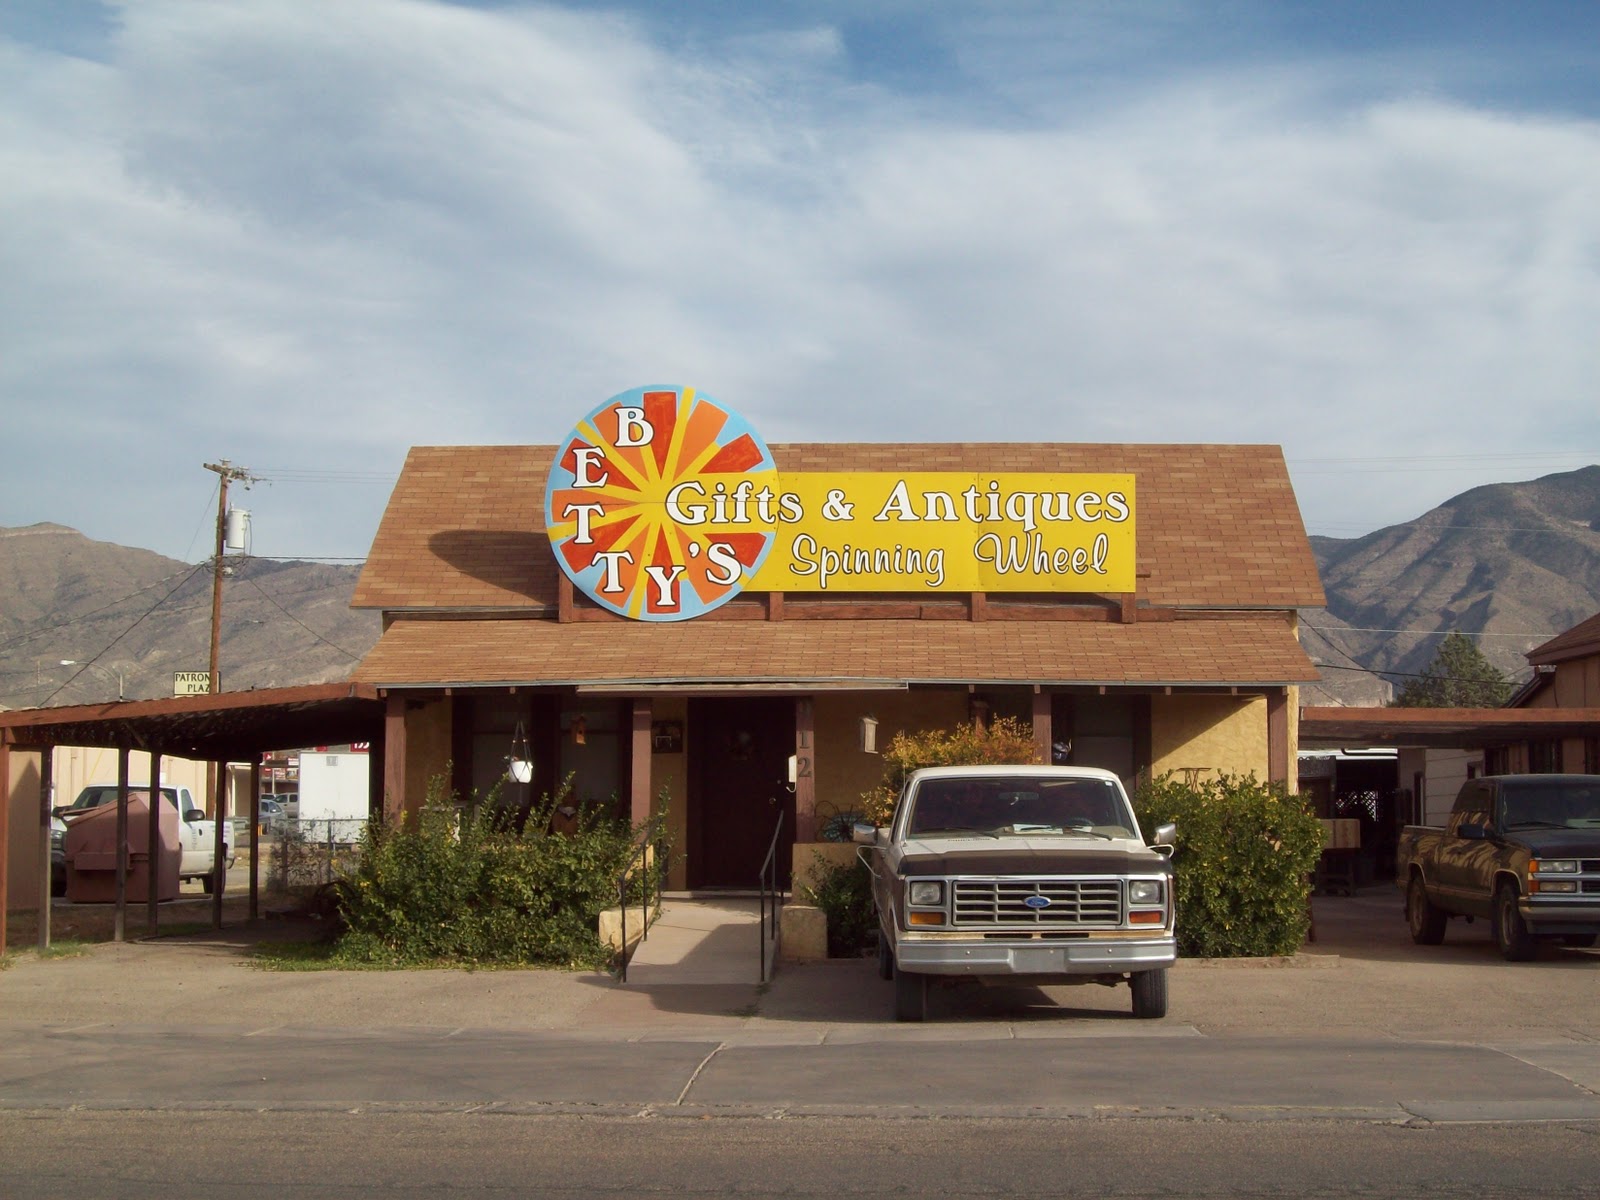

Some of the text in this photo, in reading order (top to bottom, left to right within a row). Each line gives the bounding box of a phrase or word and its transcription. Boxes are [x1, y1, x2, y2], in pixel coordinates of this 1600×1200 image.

[562, 406, 743, 606] BETTY'S
[665, 479, 1130, 532] Gifts & Antiques
[789, 531, 1109, 589] Spinning Wheel
[187, 684, 211, 693] PLAZ
